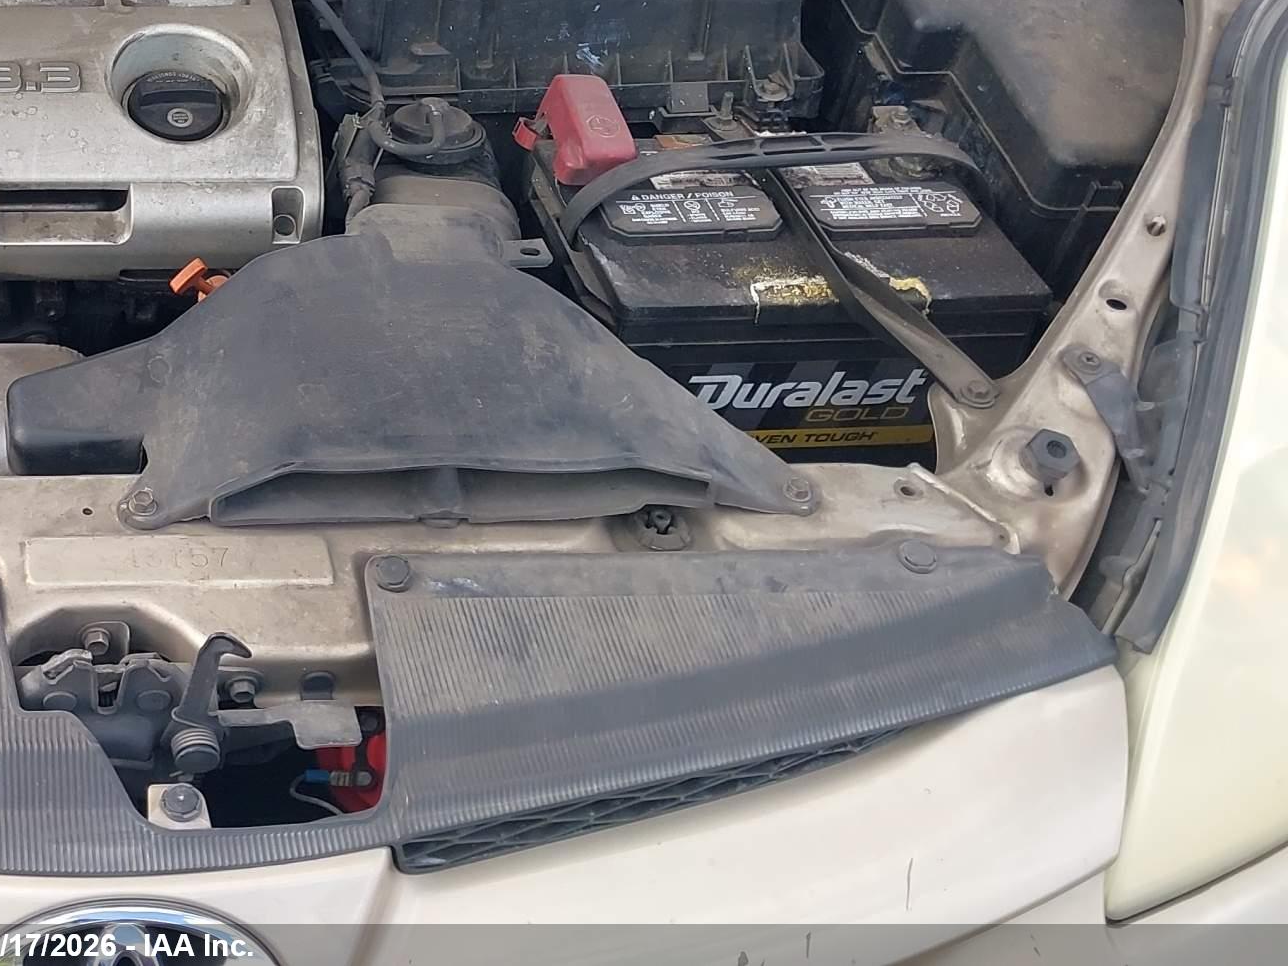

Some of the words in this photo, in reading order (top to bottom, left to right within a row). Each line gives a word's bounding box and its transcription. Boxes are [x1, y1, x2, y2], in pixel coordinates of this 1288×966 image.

[688, 369, 929, 409] Duralast
[805, 407, 909, 422] GOLD
[755, 434, 797, 444] VEN
[804, 433, 874, 443] TOUGH
